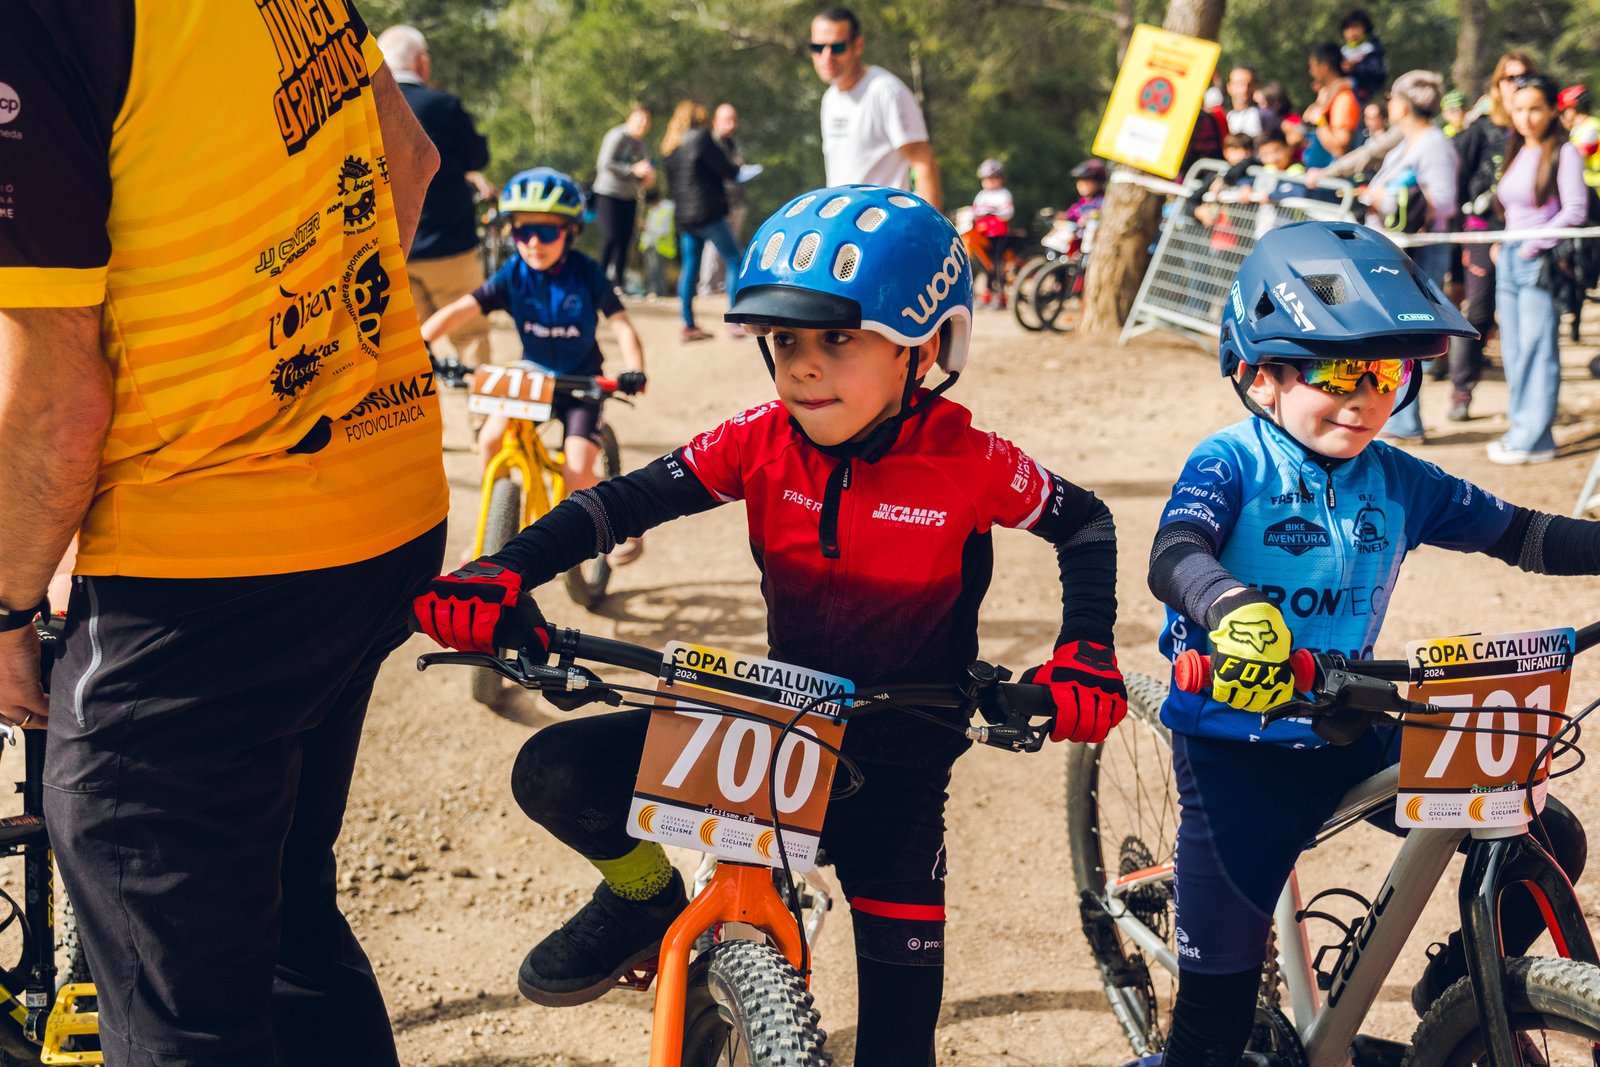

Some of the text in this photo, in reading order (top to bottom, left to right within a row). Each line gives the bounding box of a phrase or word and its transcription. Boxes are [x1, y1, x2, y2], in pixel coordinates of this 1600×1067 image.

[278, 212, 321, 261] CNTER
[901, 237, 967, 324] woom
[481, 362, 545, 400] 711
[345, 404, 425, 443] FOTOVOLTAICA
[890, 505, 948, 527] CAMPS
[1285, 523, 1306, 531] BIKE
[1267, 533, 1327, 544] AVENTURA
[1249, 582, 1385, 620] RONTEC
[1416, 633, 1569, 666] COPA CATALUNYA
[673, 647, 846, 698] COPA CATALUNYA
[675, 669, 698, 681] 2024
[1218, 657, 1282, 685] FOX
[1424, 669, 1445, 678] 2024
[1424, 684, 1551, 778] 701
[661, 700, 821, 814] 700
[660, 824, 693, 836] CICLISME
[721, 837, 752, 848] CICLISME
